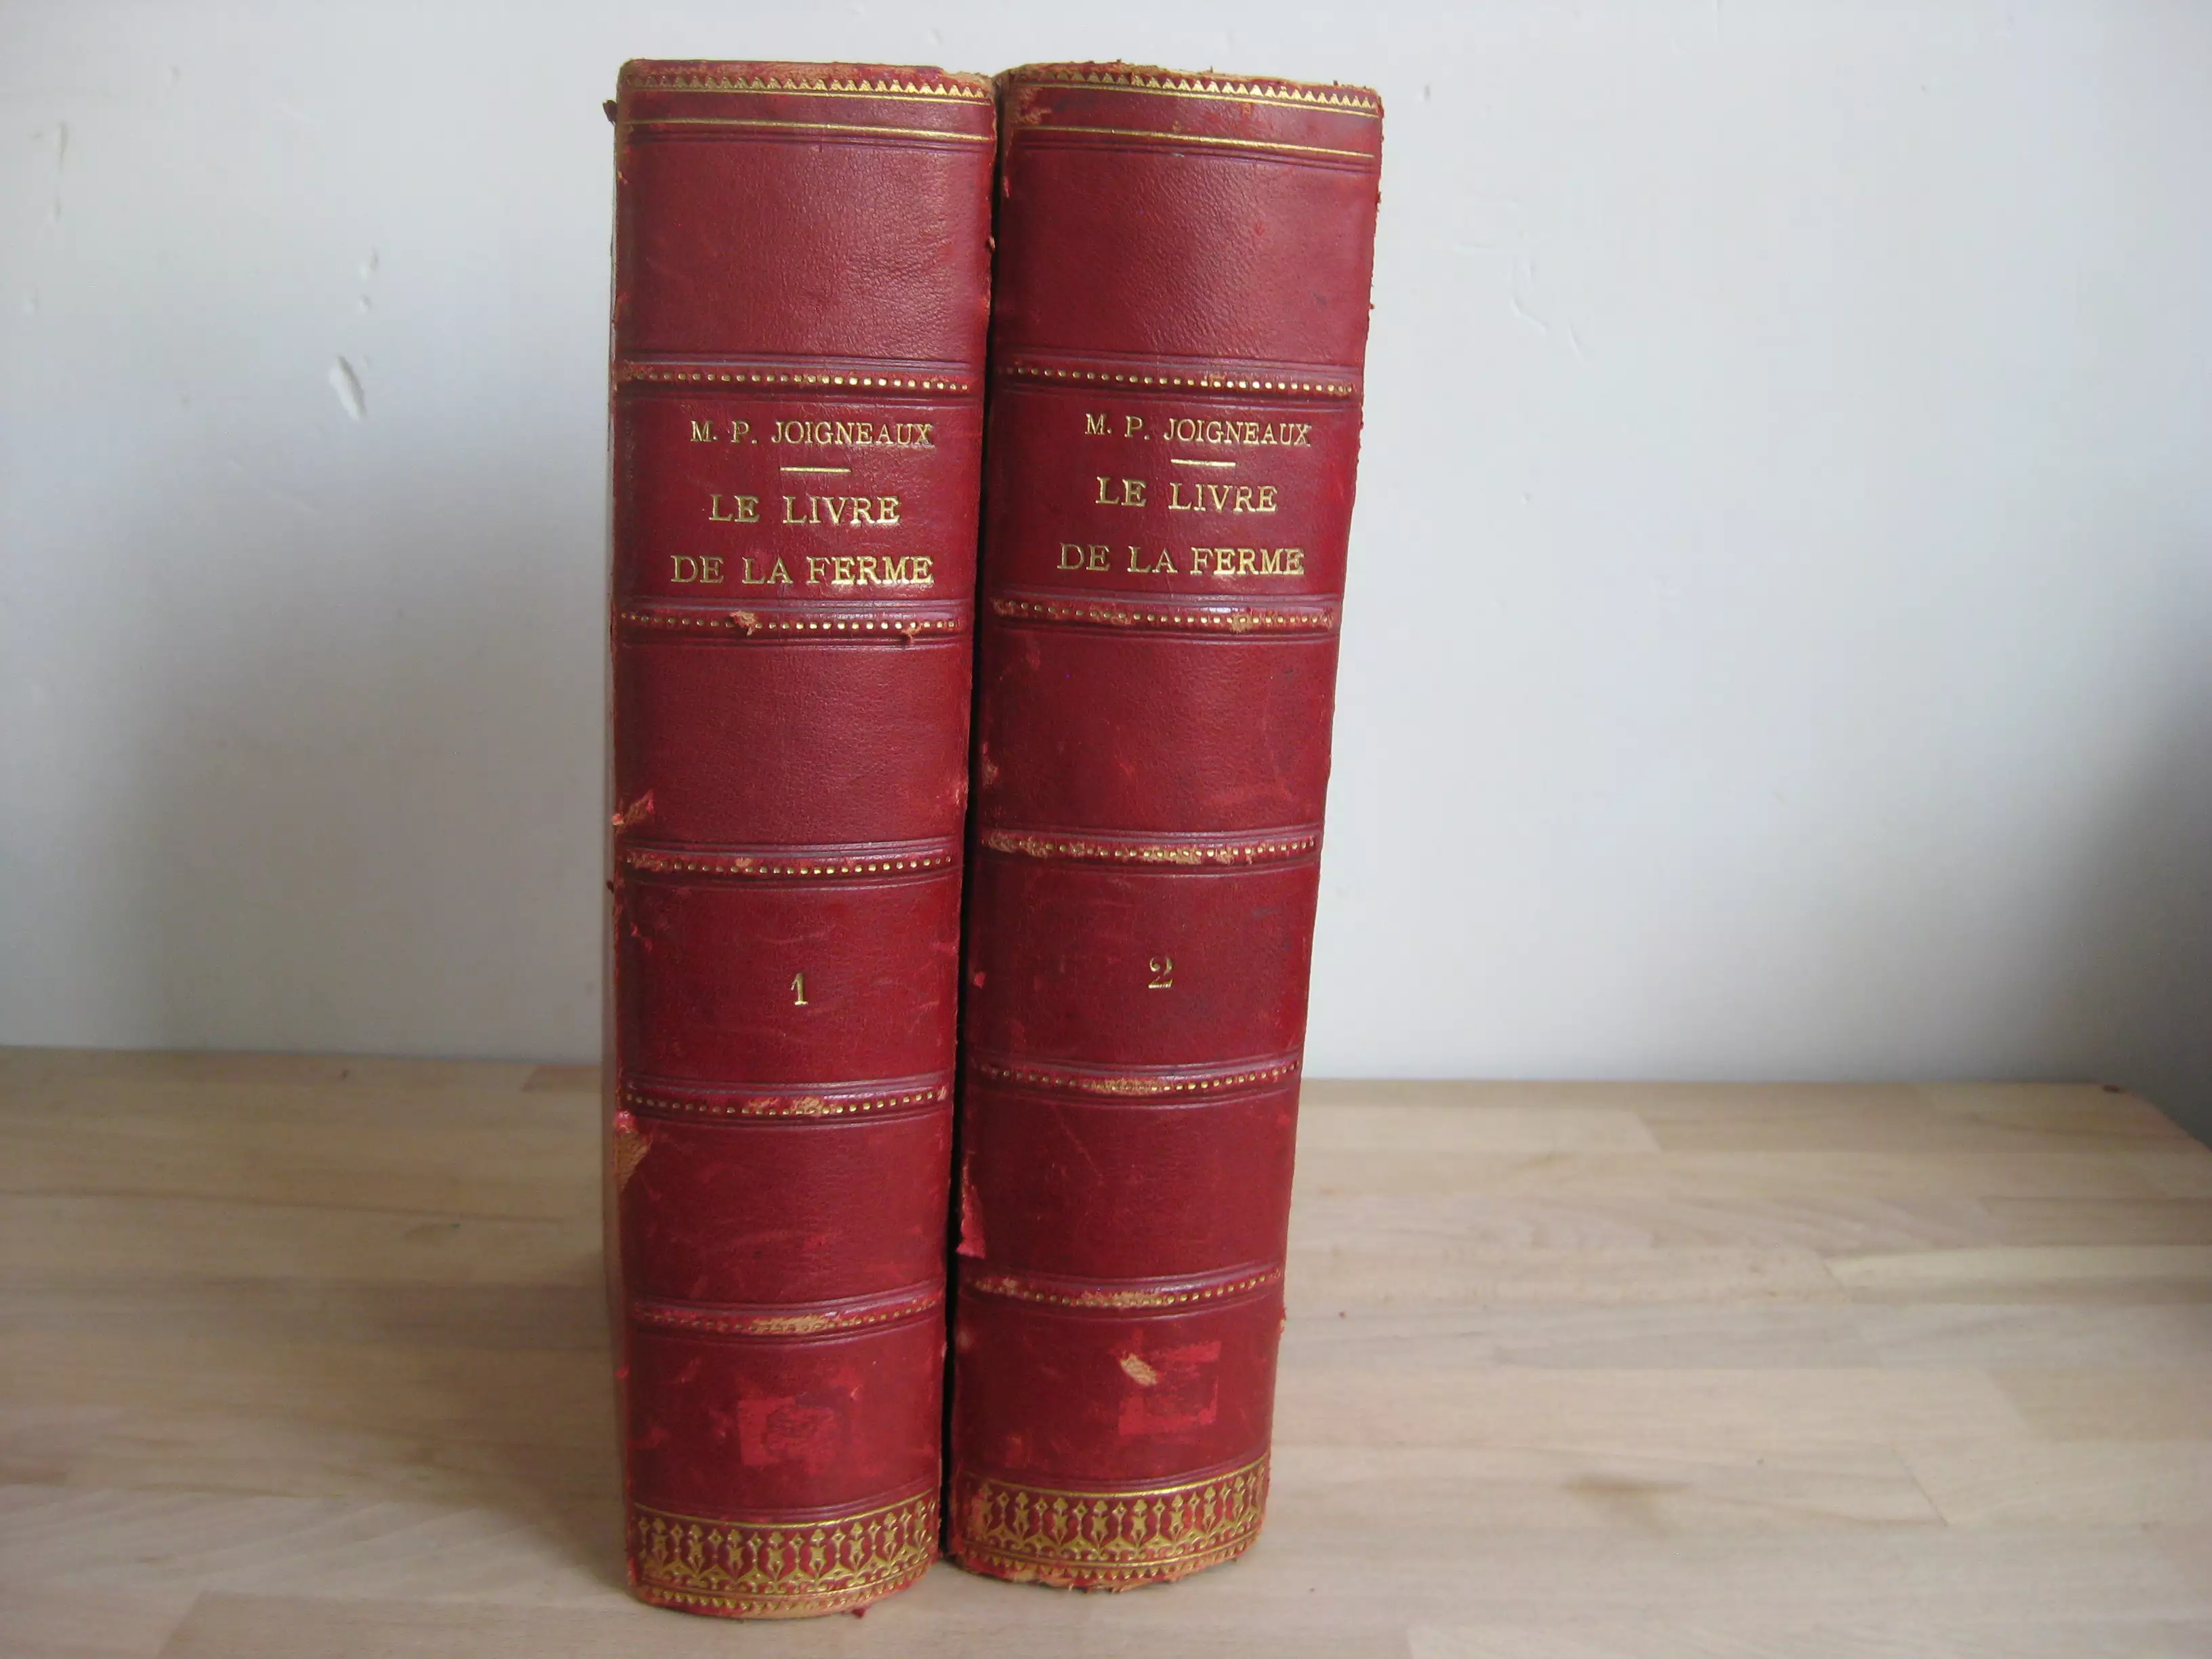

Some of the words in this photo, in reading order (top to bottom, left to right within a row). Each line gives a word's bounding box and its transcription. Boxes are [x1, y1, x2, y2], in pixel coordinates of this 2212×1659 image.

[690, 420, 718, 443] M.
[731, 420, 758, 445] P.
[771, 420, 935, 447] JOIGNEAUX
[1084, 413, 1113, 435] M.
[1124, 415, 1151, 441] P.
[1163, 418, 1311, 447] JOIGNEAUX
[709, 493, 760, 523] LE
[782, 495, 901, 525] LIVRE
[1095, 476, 1147, 507] LE
[1168, 482, 1278, 513] LIVRE
[670, 554, 724, 584] DE
[741, 556, 794, 585] LA
[805, 555, 935, 586] FERME
[1057, 542, 1111, 571] DE
[1126, 545, 1178, 574] LA
[1189, 546, 1306, 575] FERME
[790, 972, 808, 1006] 1
[1147, 956, 1174, 989] 2
